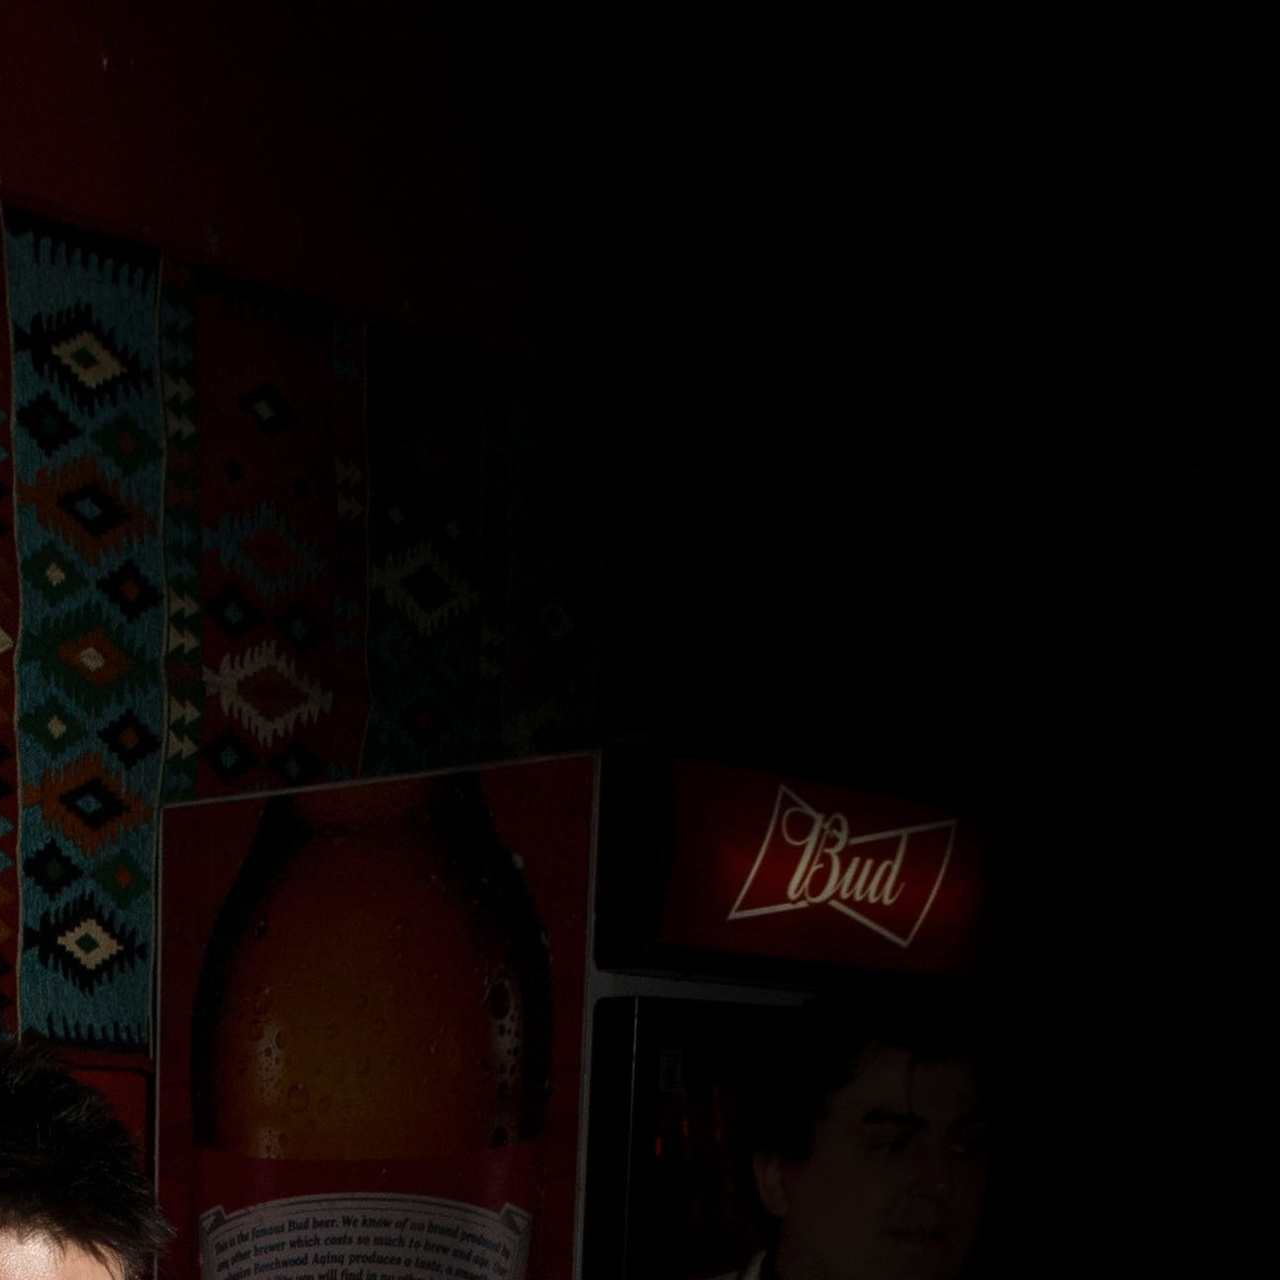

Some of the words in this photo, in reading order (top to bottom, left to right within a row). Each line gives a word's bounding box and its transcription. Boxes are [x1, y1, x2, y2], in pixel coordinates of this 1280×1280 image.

[781, 805, 907, 907] Bud
[231, 1248, 251, 1265] other
[253, 1240, 286, 1256] brewer
[289, 1234, 320, 1249] which
[324, 1233, 353, 1246] costs
[357, 1234, 370, 1245] so
[373, 1233, 405, 1248] much
[408, 1236, 421, 1249] to
[423, 1239, 451, 1255] brew
[451, 1247, 473, 1263] and
[237, 1231, 249, 1244] the
[252, 1223, 285, 1240] famous
[288, 1217, 310, 1232] Bud
[312, 1216, 339, 1230] beer.
[342, 1215, 358, 1227] We
[361, 1215, 392, 1228] know
[395, 1217, 409, 1232] of
[410, 1222, 425, 1232] no
[427, 1221, 460, 1239] brand
[460, 1229, 501, 1252] produced
[254, 1252, 309, 1275] Beechwood
[311, 1249, 345, 1267] Aging
[348, 1250, 402, 1266] produces
[404, 1257, 412, 1267] a
[415, 1256, 444, 1275] taste,
